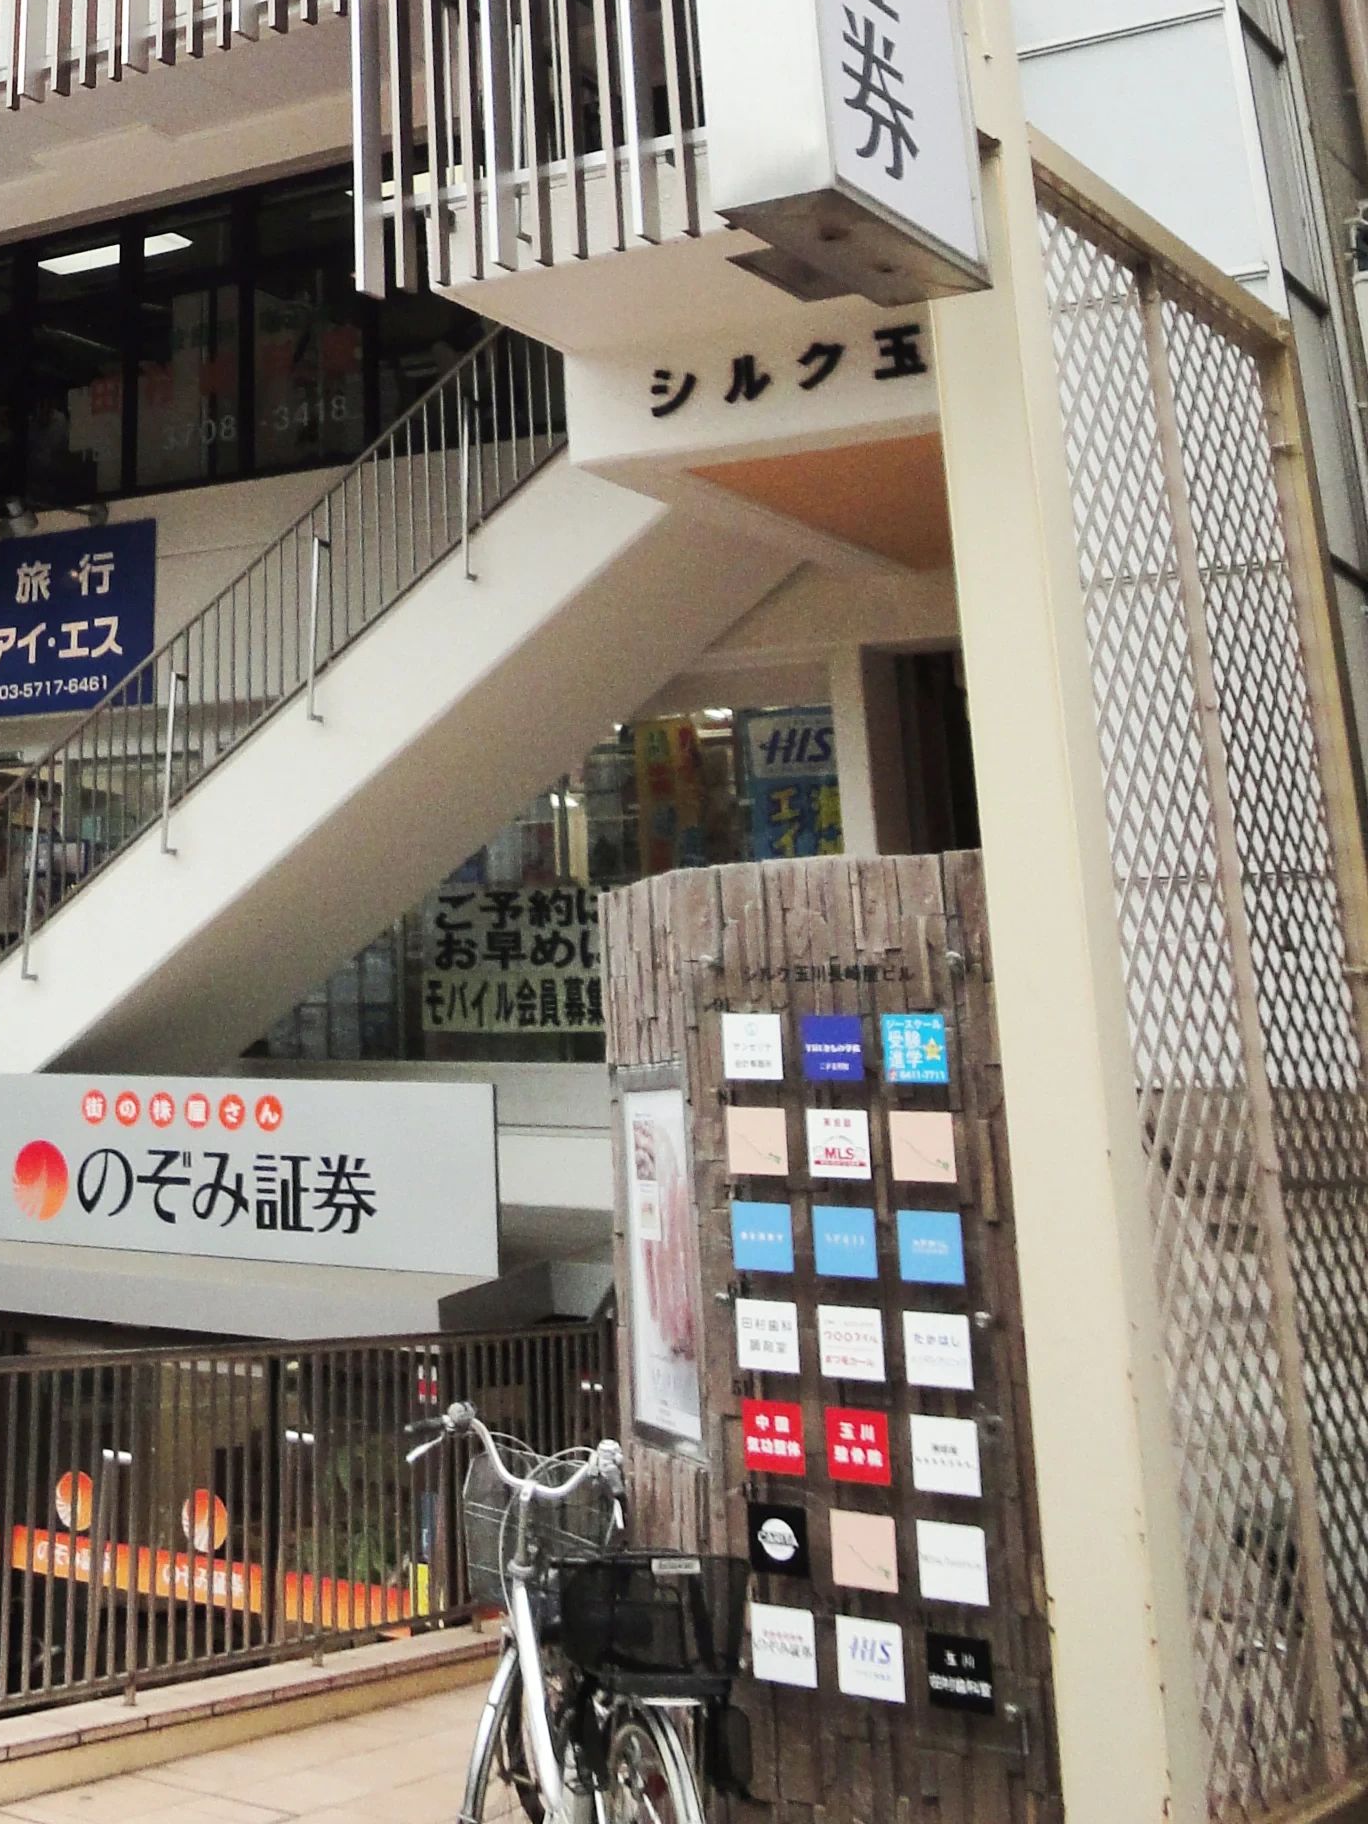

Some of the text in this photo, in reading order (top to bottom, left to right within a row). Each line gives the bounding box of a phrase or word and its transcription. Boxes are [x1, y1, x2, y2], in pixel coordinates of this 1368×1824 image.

[0, 675, 108, 701] 03-5717-6461
[824, 1146, 856, 1160] MLS
[77, 1148, 378, 1235] のぞみ証券
[913, 1332, 960, 1348] たかはし
[839, 1421, 876, 1443] 玉川
